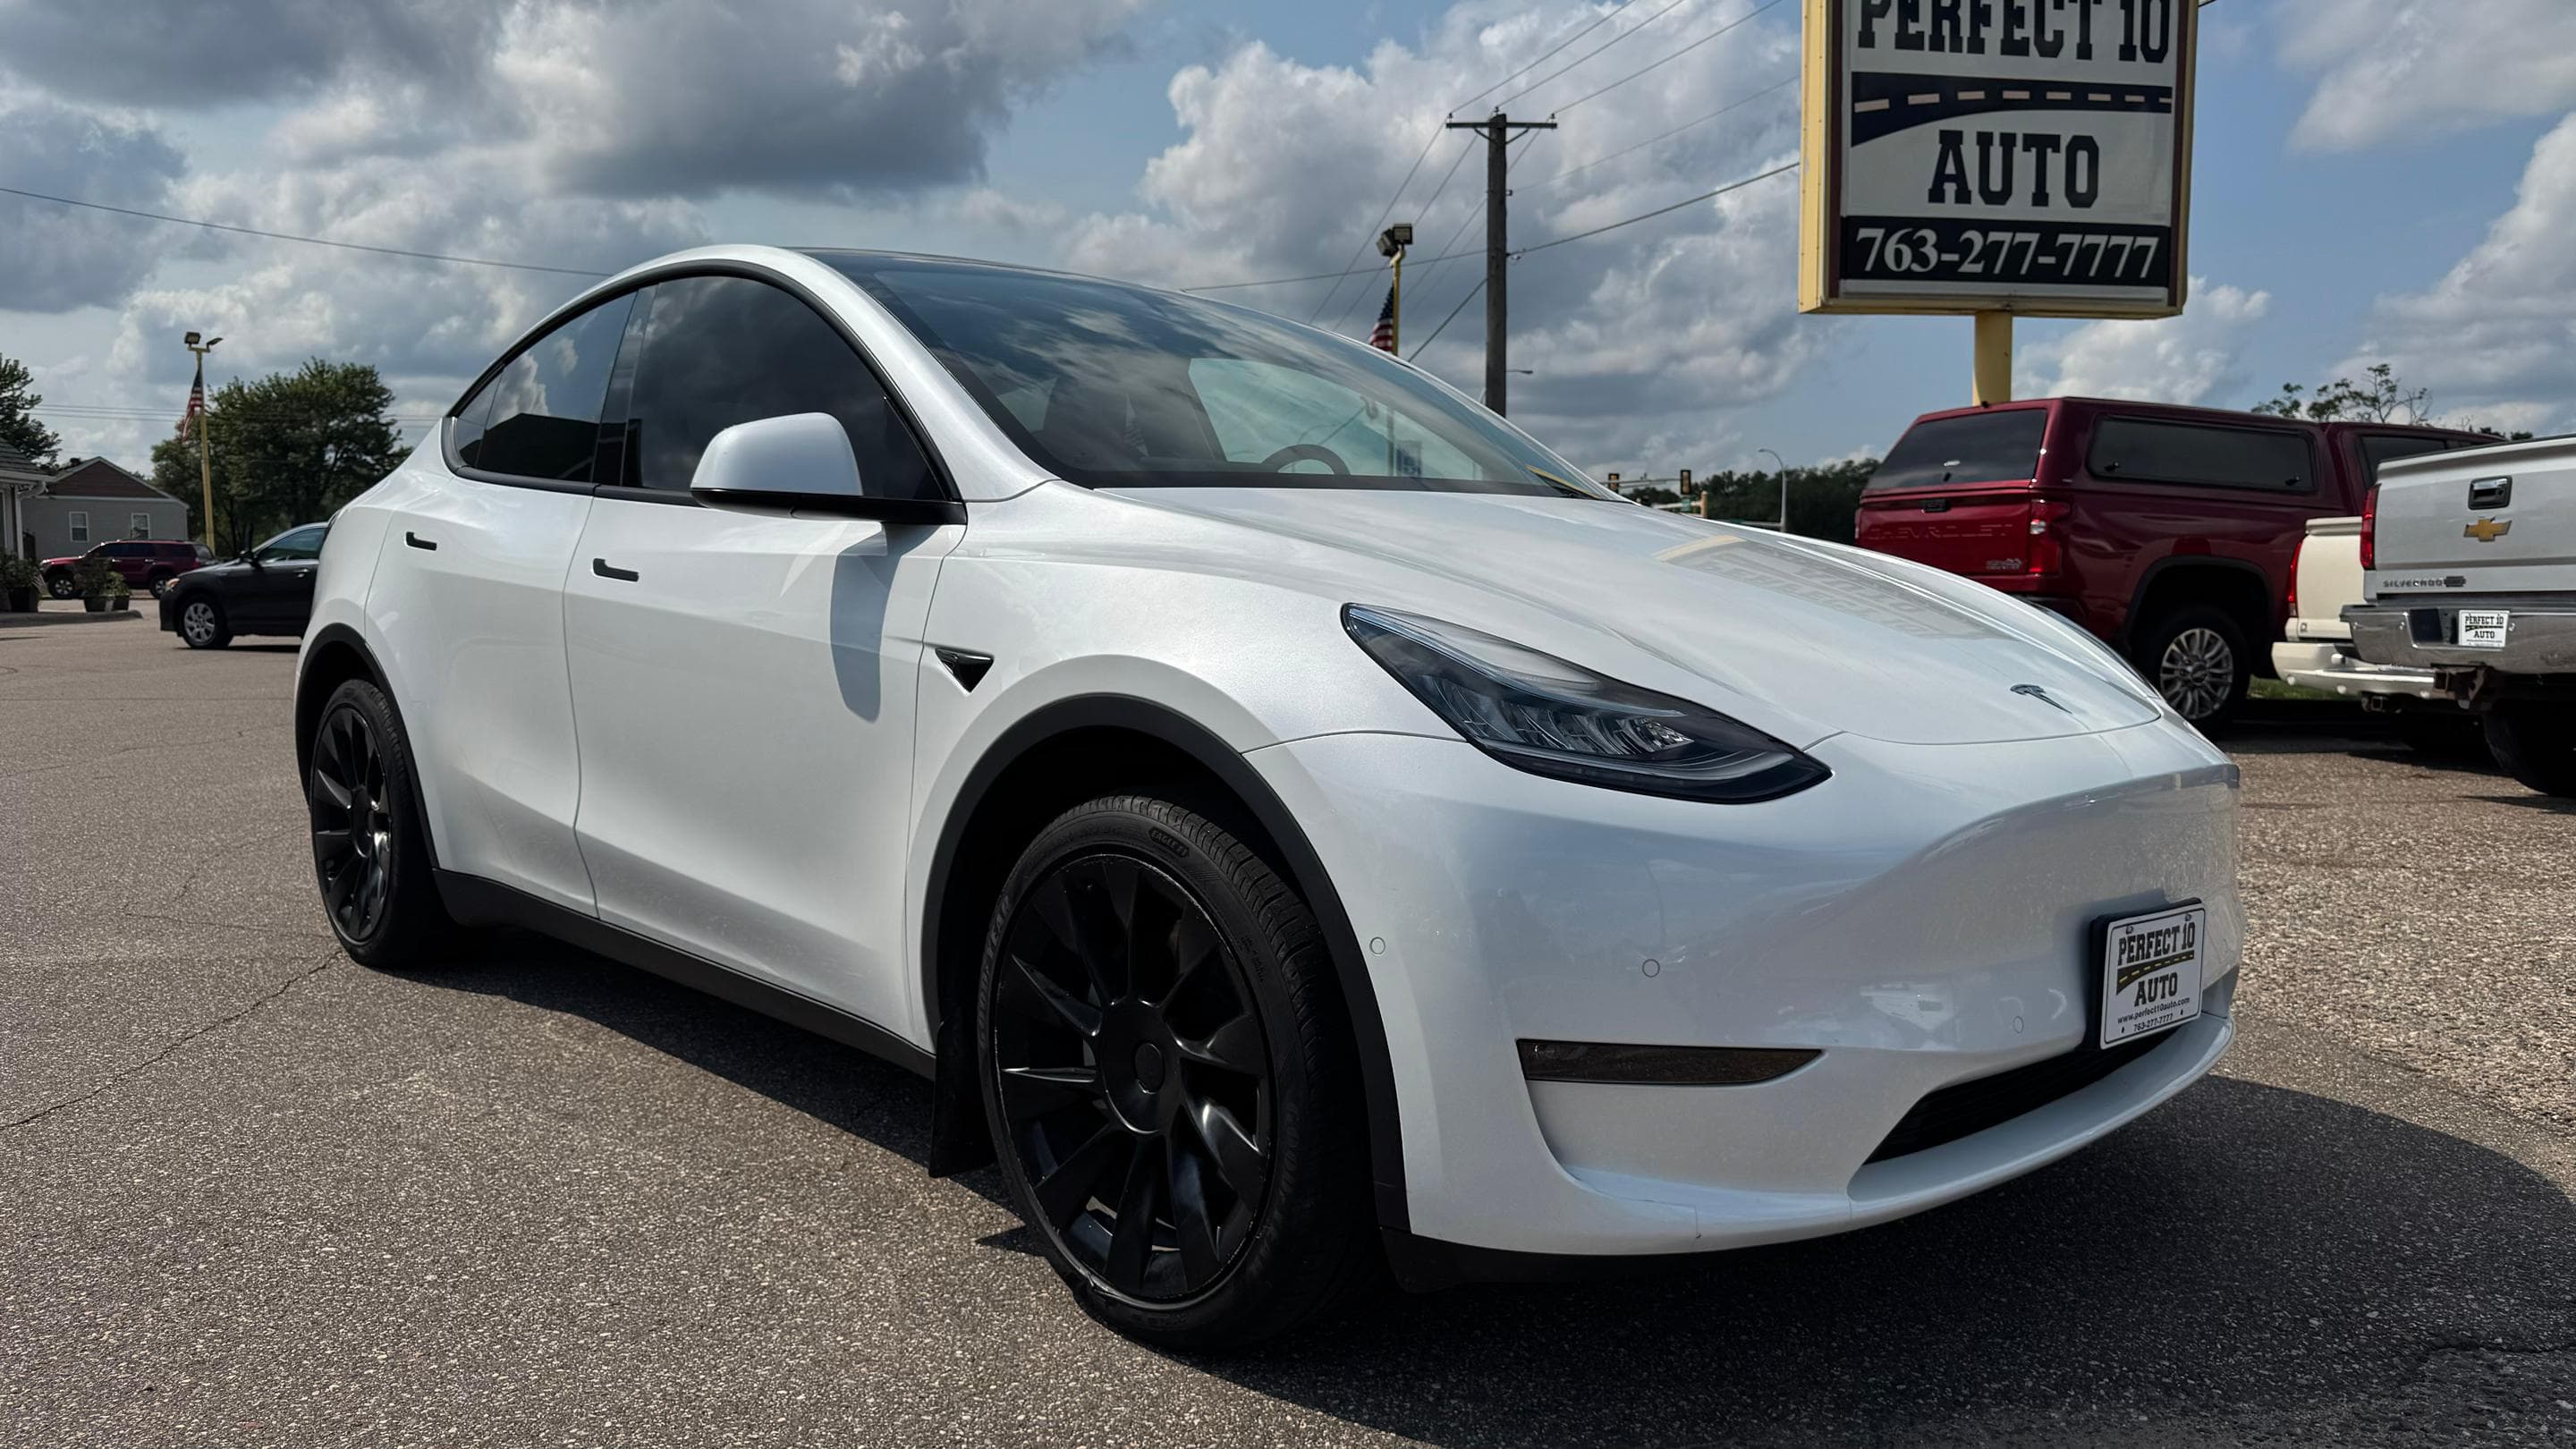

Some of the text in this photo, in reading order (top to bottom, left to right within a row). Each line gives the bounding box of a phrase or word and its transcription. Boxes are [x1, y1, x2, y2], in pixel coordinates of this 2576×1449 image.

[1858, 0, 2170, 64] PERFECT 10
[1928, 130, 2099, 208] AUTO
[1855, 227, 2159, 279] 763-277-7777
[2465, 615, 2495, 624] PERFECT
[2474, 631, 2496, 639] AUTO
[2118, 921, 2196, 966] PERFECT 10
[2134, 971, 2178, 1007] AUTO
[2118, 997, 2190, 1023] www.perfect10auto.com
[2133, 1013, 2174, 1031] 763-277-7777
